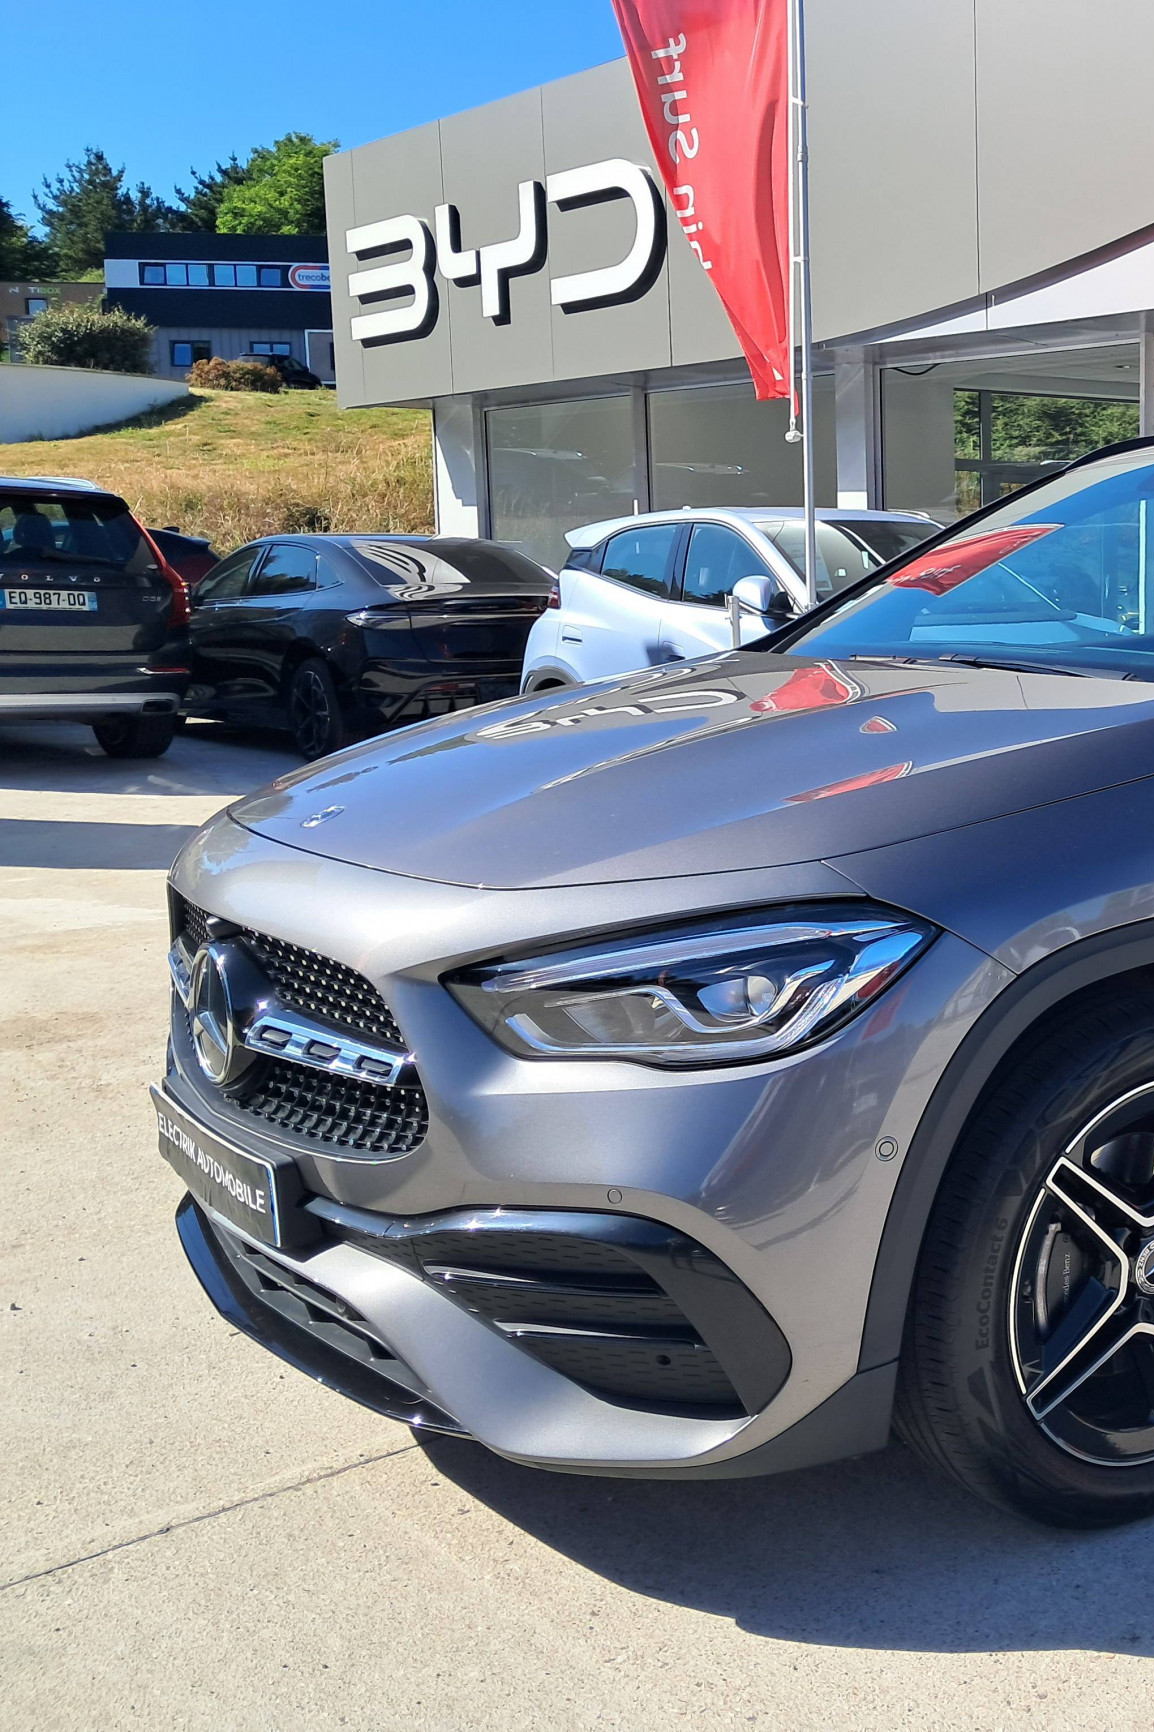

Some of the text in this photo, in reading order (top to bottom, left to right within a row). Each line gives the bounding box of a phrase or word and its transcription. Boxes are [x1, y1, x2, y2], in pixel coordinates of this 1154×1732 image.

[345, 158, 655, 342] BYD
[8, 591, 87, 607] EQ-987-DQ
[158, 1112, 266, 1214] ELECTRIK AUTOMOBILE
[975, 1232, 1004, 1351] EcoContact
